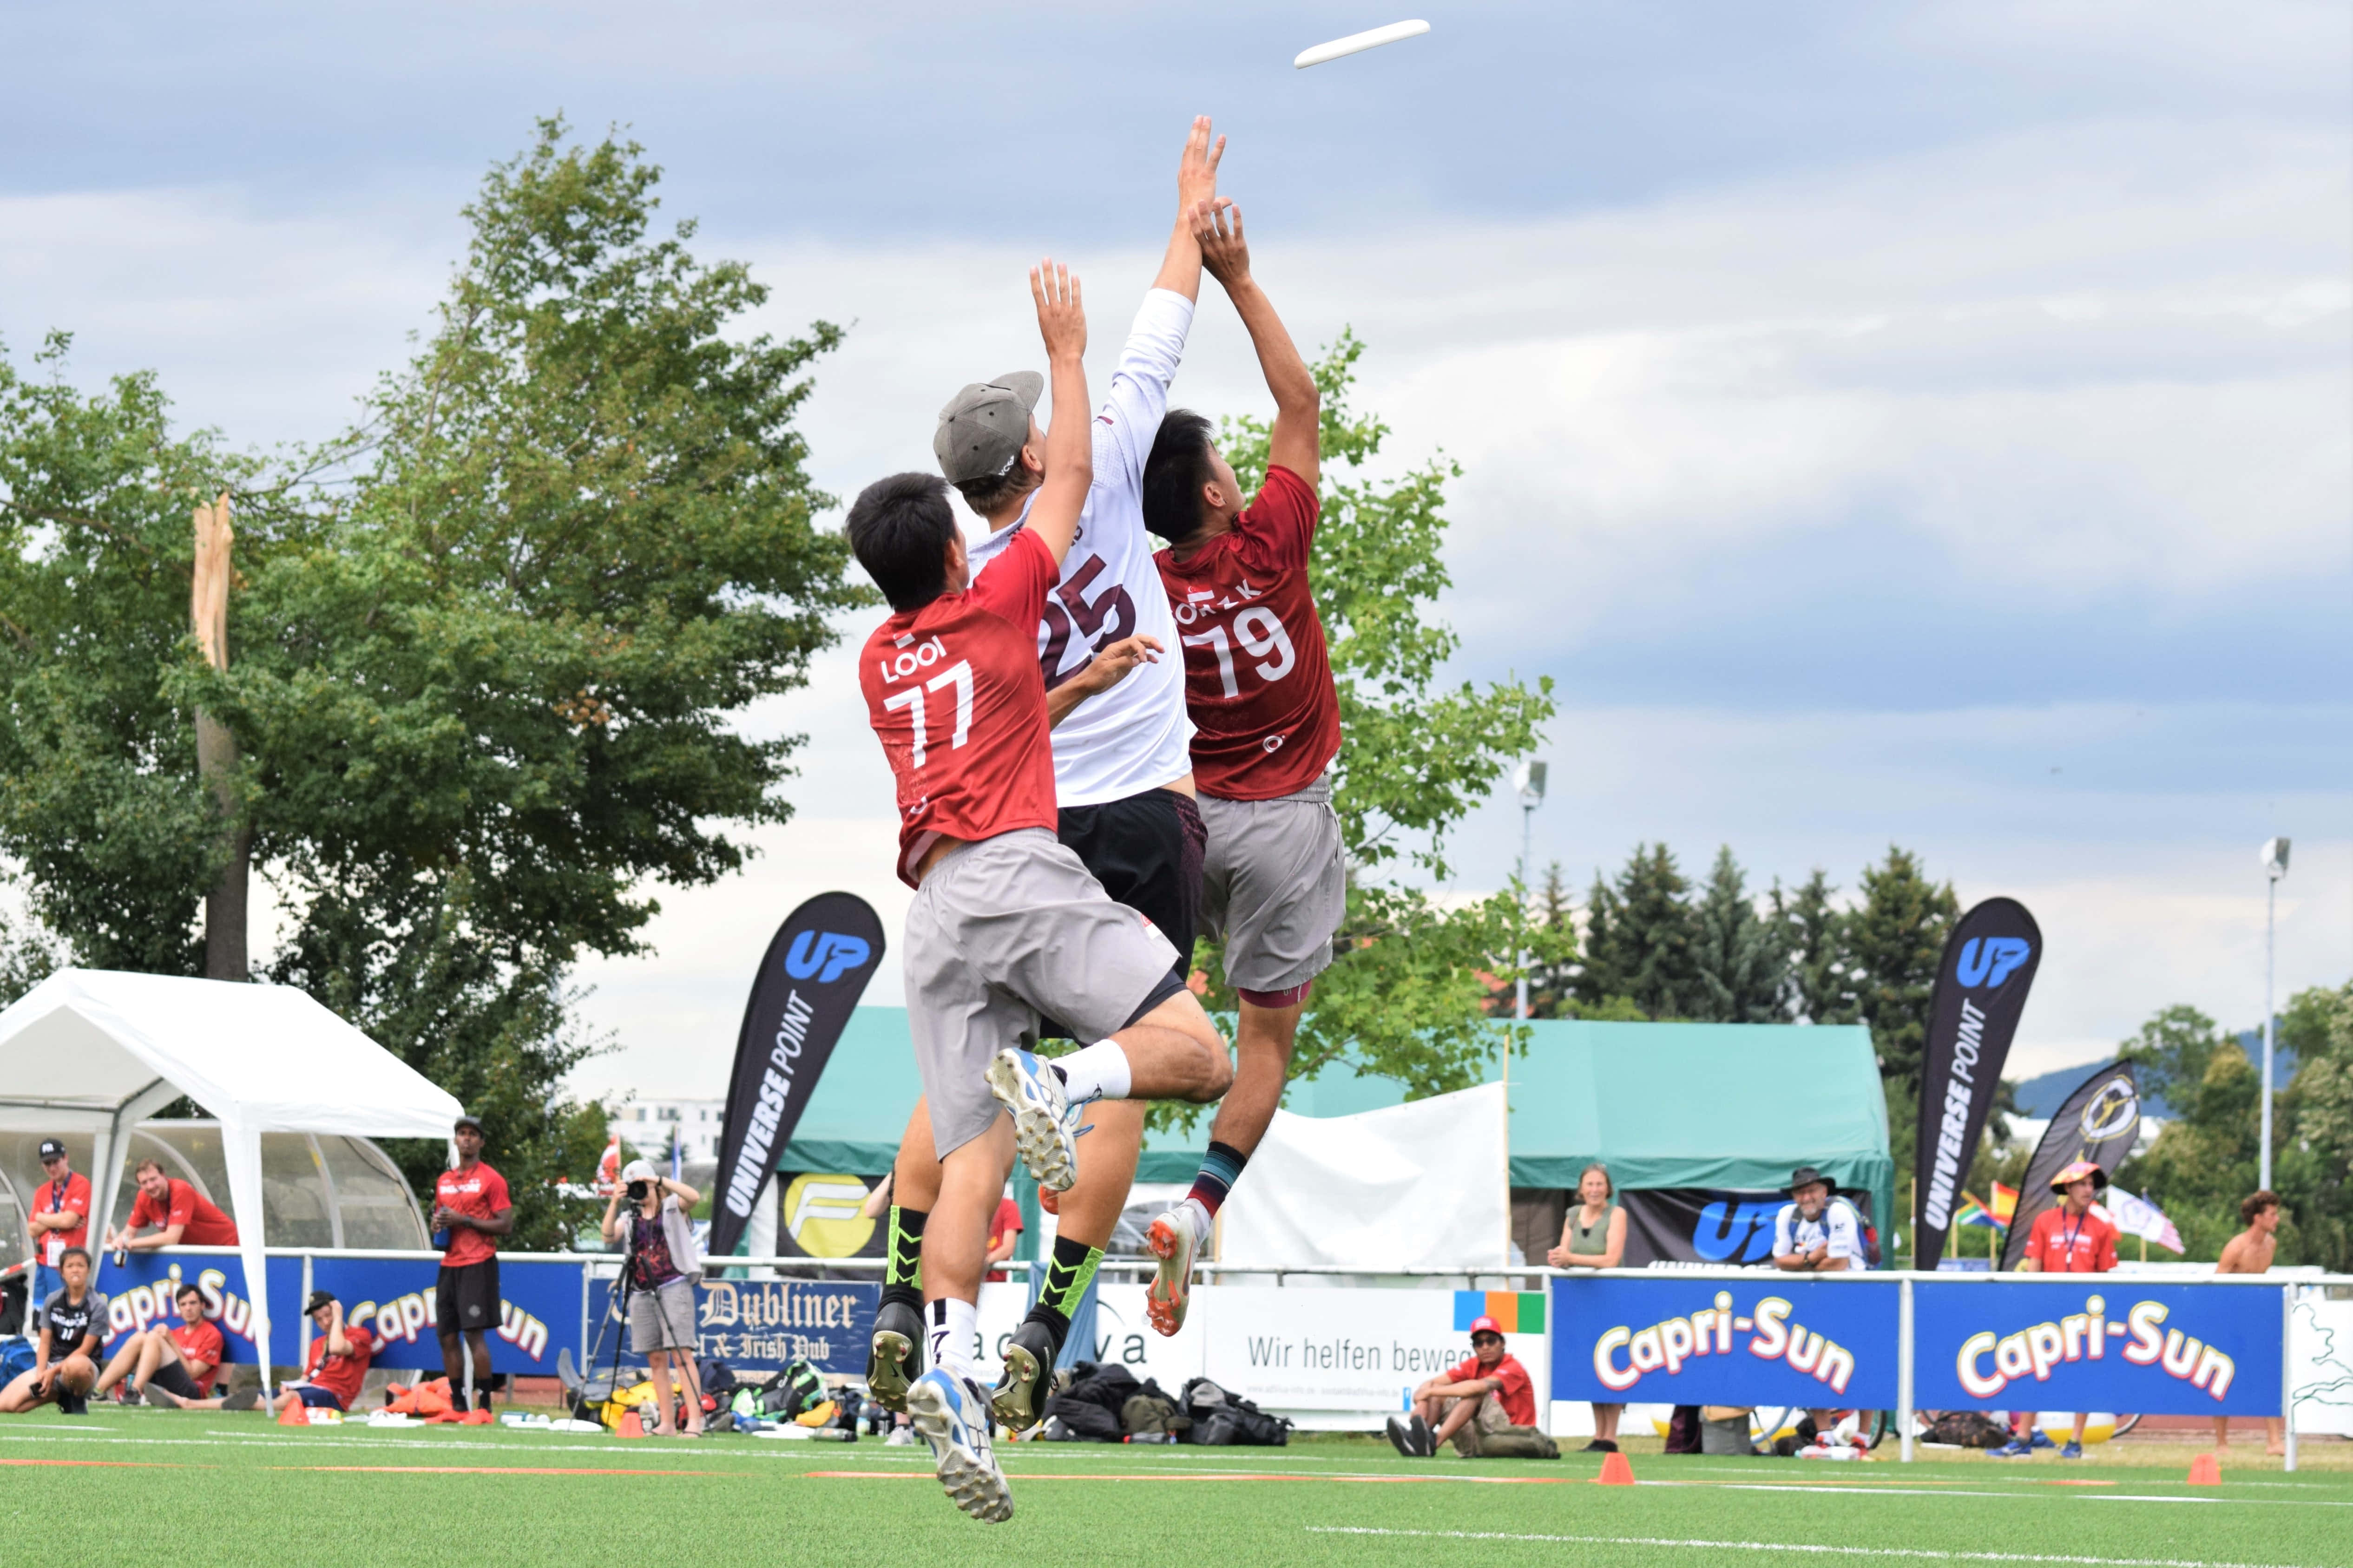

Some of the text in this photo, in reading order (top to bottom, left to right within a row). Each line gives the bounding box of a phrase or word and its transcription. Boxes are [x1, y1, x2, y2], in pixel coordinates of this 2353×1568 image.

[881, 635, 947, 684] LOOI
[1182, 606, 1295, 699] 79
[884, 659, 974, 769] 77
[726, 989, 814, 1218] UNIVERSE POINT
[1925, 997, 1986, 1231] UNIVERSE POINT
[699, 1281, 859, 1329] Dubliner
[738, 1332, 787, 1362] Irish
[791, 1334, 830, 1361] Pub
[1248, 1336, 1293, 1367] Wir
[1304, 1338, 1380, 1370] helfen
[1593, 1291, 1855, 1395] Capri-Sun
[1956, 1294, 2235, 1402] Capri-Sun
